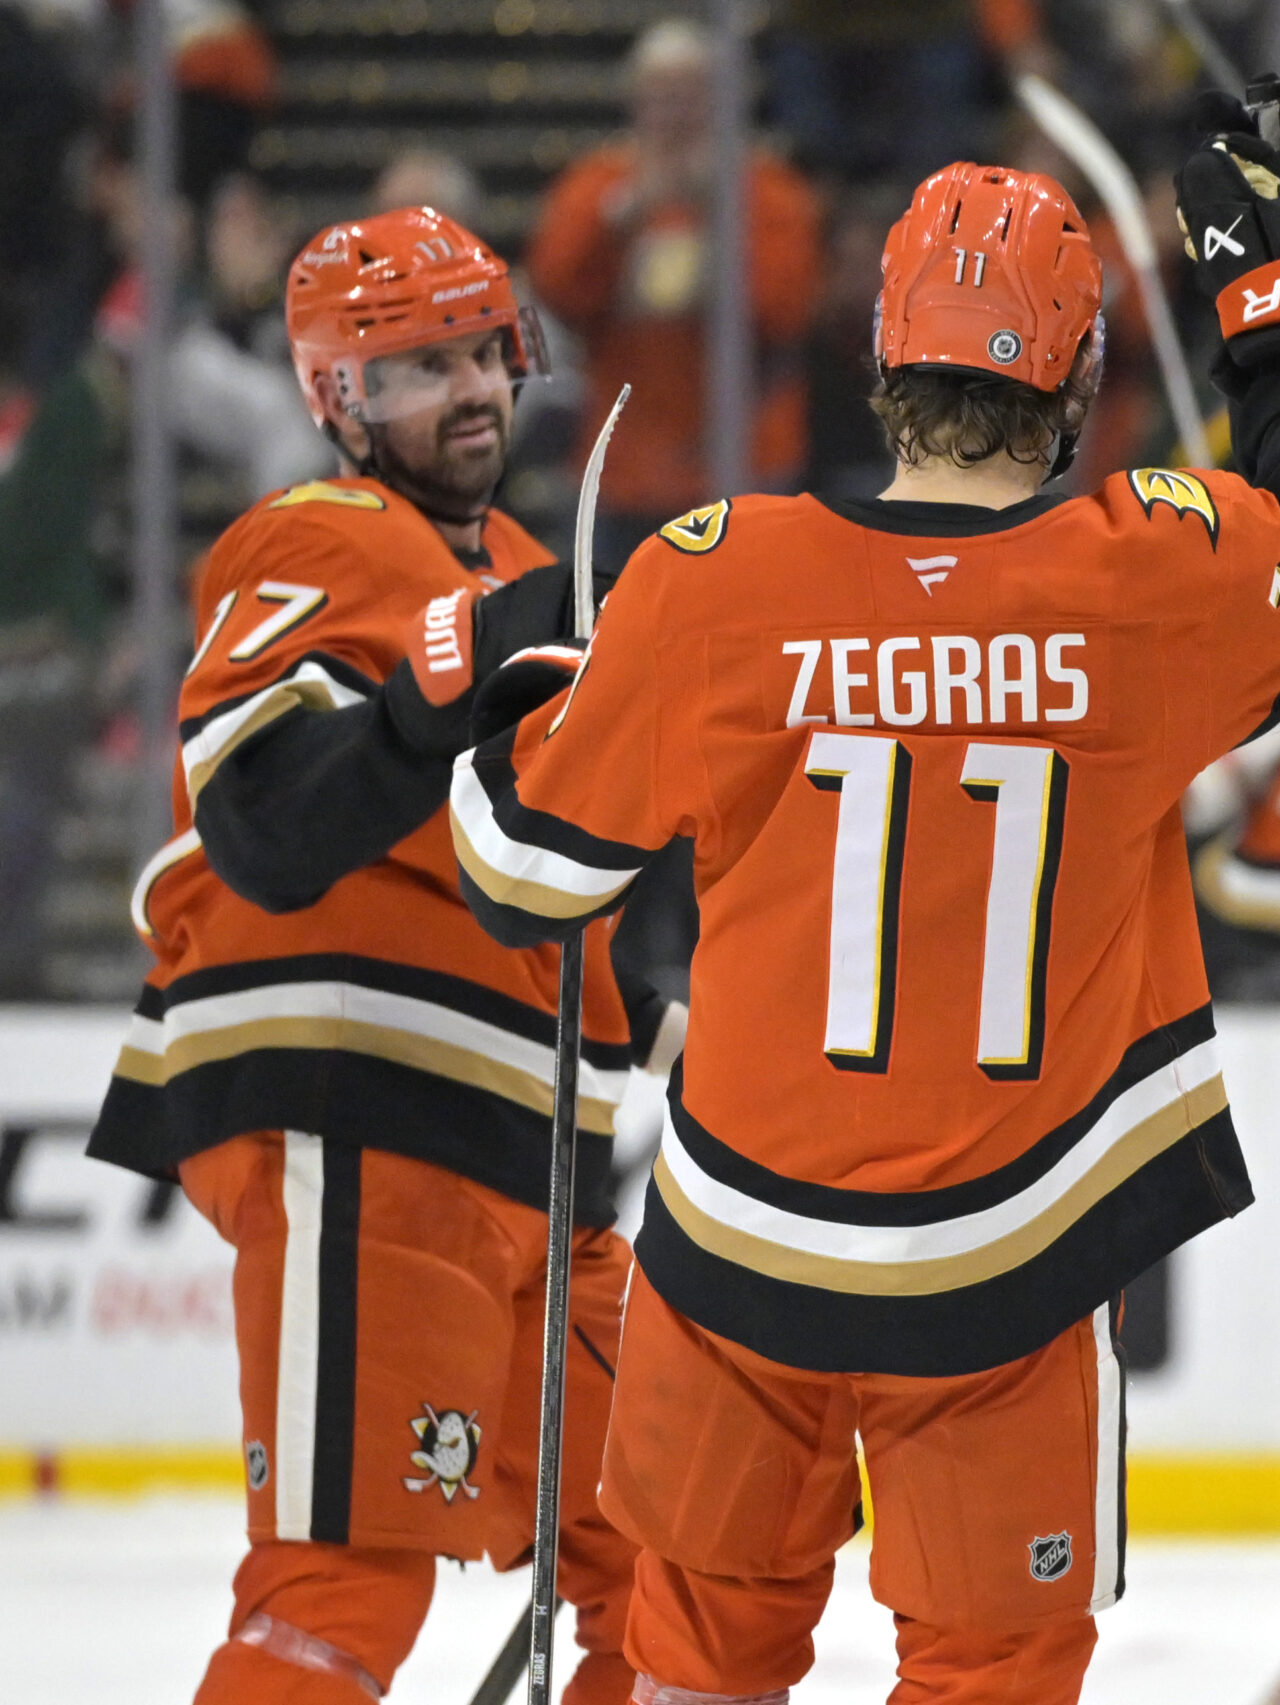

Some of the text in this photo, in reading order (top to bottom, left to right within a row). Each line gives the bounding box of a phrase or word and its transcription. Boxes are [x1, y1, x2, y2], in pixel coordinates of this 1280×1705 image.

[954, 249, 986, 288] 11
[781, 633, 1090, 728] ZEGRAS
[804, 731, 1071, 1082] 11
[1039, 1543, 1066, 1574] NHL
[533, 1652, 546, 1686] ZEGRAS
